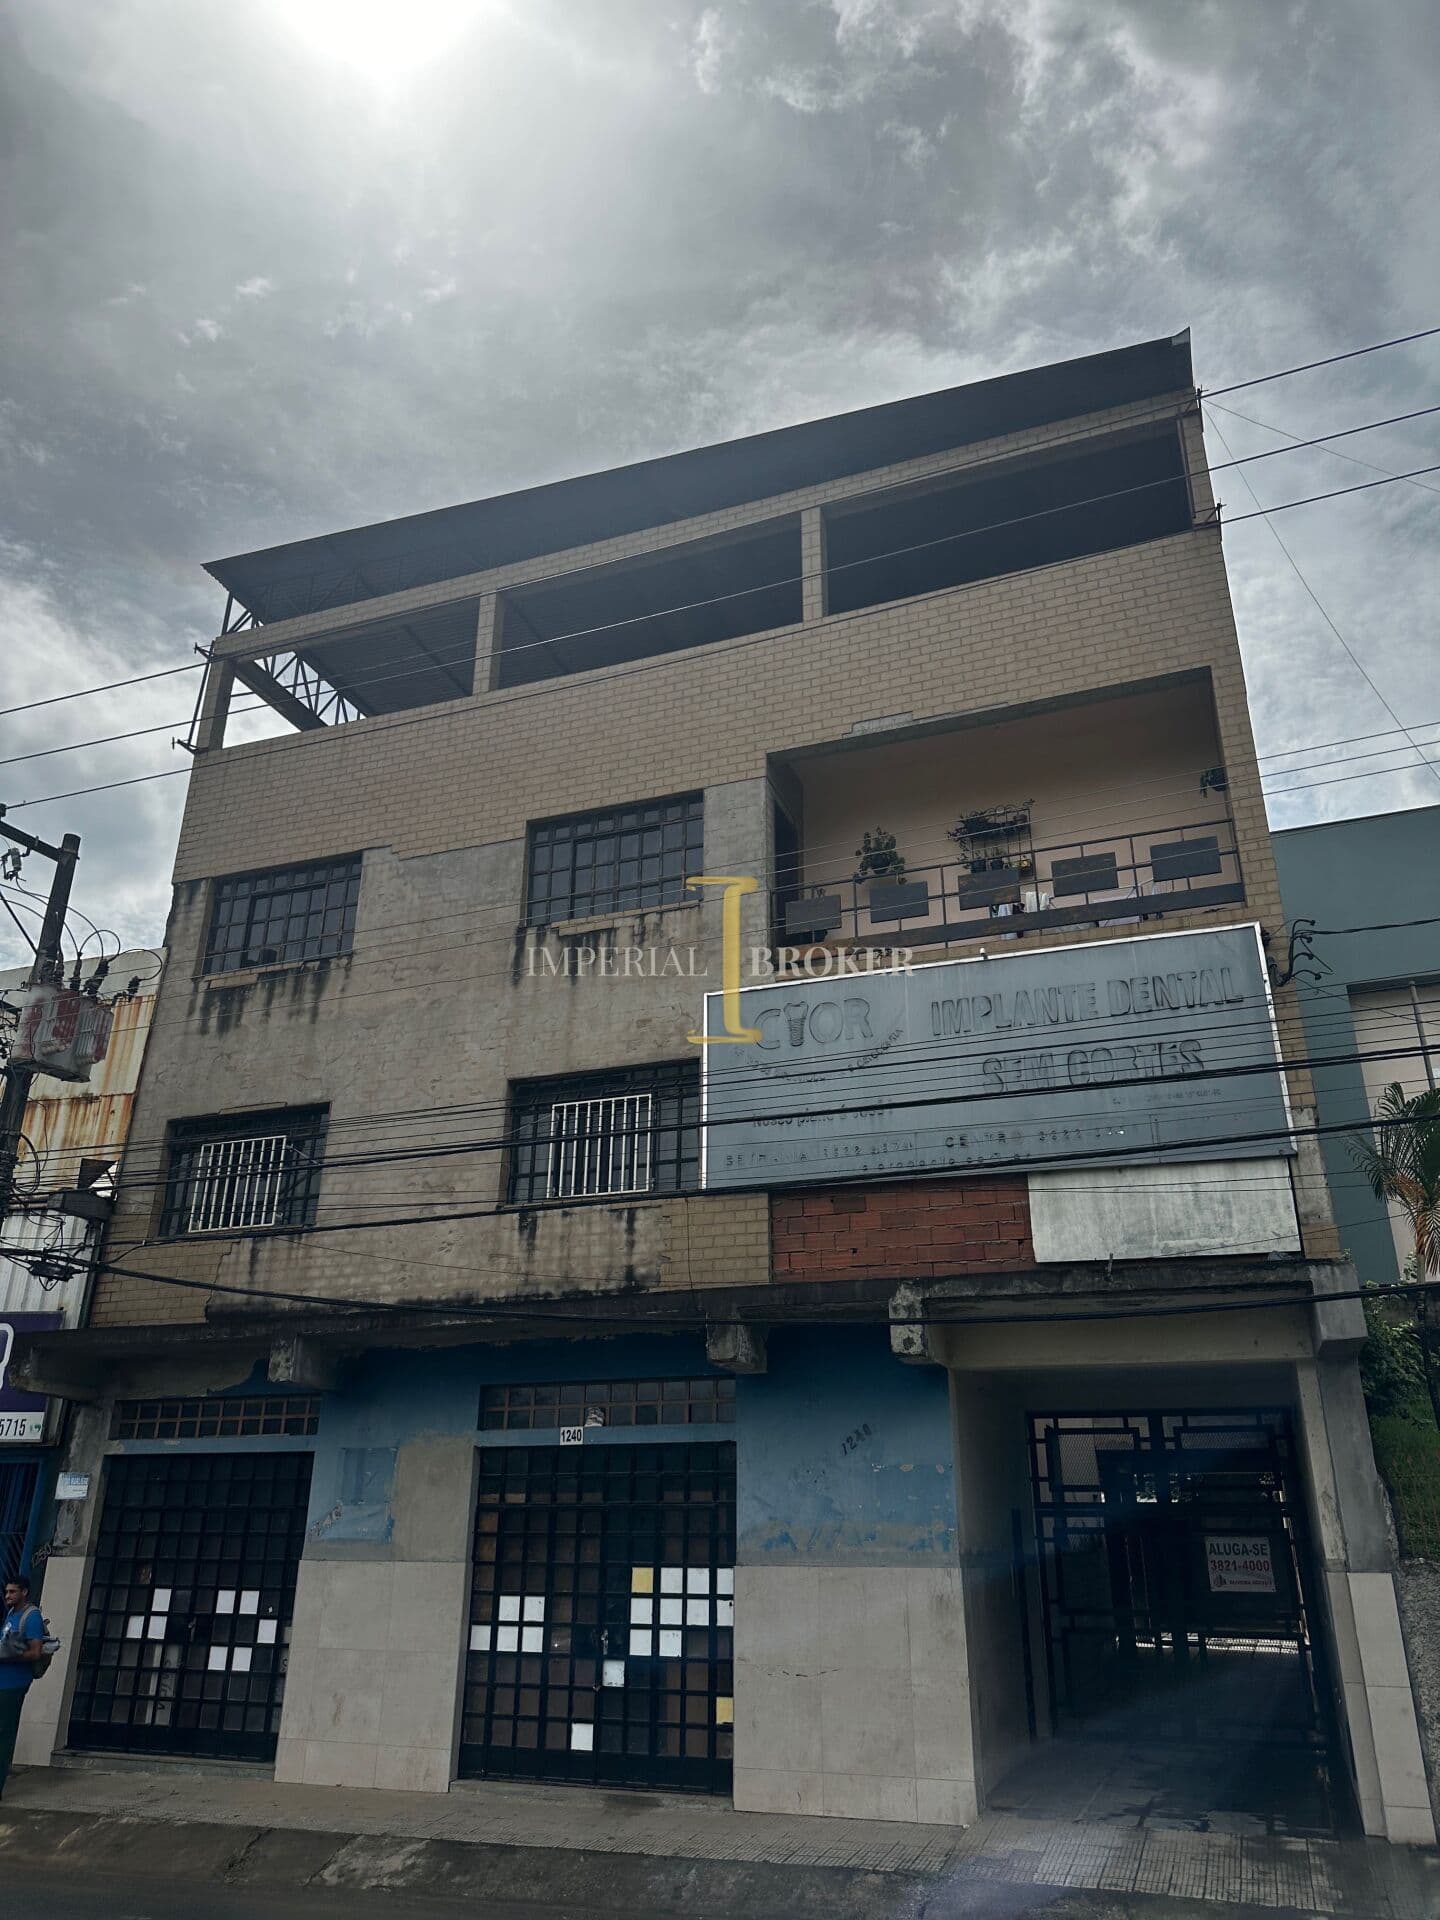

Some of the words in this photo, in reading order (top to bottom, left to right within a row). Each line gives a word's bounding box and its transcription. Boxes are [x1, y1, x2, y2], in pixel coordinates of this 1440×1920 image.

[931, 982, 1097, 1037] IMPLANTE
[1107, 967, 1243, 1017] DENTAL
[982, 1051, 1056, 1094] SEM
[561, 1429, 582, 1443] 1240
[1208, 1542, 1269, 1556] ALUGA-SE
[1210, 1559, 1270, 1572] 3821-4000
